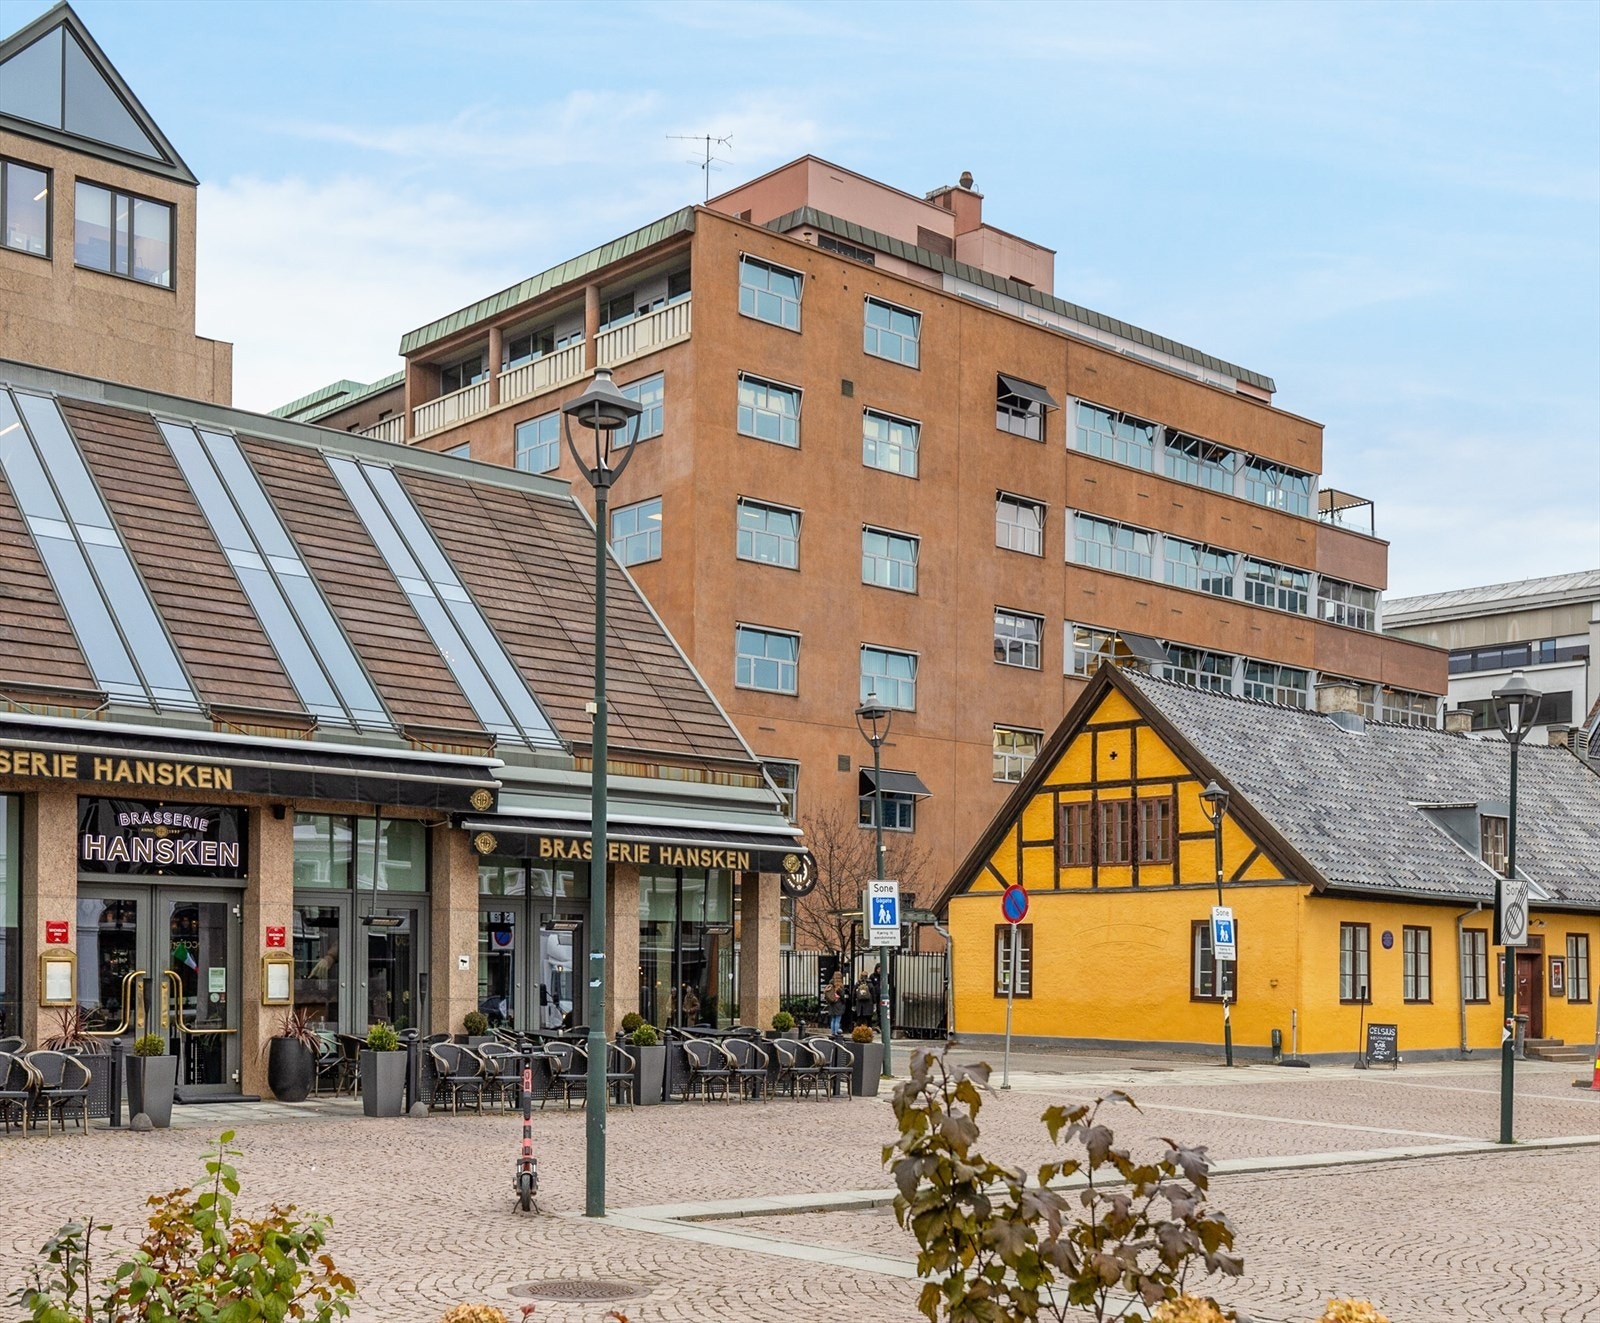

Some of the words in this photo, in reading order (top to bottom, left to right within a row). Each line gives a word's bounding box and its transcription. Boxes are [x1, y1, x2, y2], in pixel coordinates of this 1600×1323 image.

[94, 757, 233, 790] HANSKEN
[119, 811, 209, 831] BRASSERIE
[85, 834, 240, 867] HANSKEN
[540, 837, 650, 864] BRASERIE
[659, 845, 750, 870] HANSKEN
[873, 884, 894, 893] Sone
[1216, 908, 1229, 916] Sone
[1369, 1027, 1396, 1036] CELSIUS
